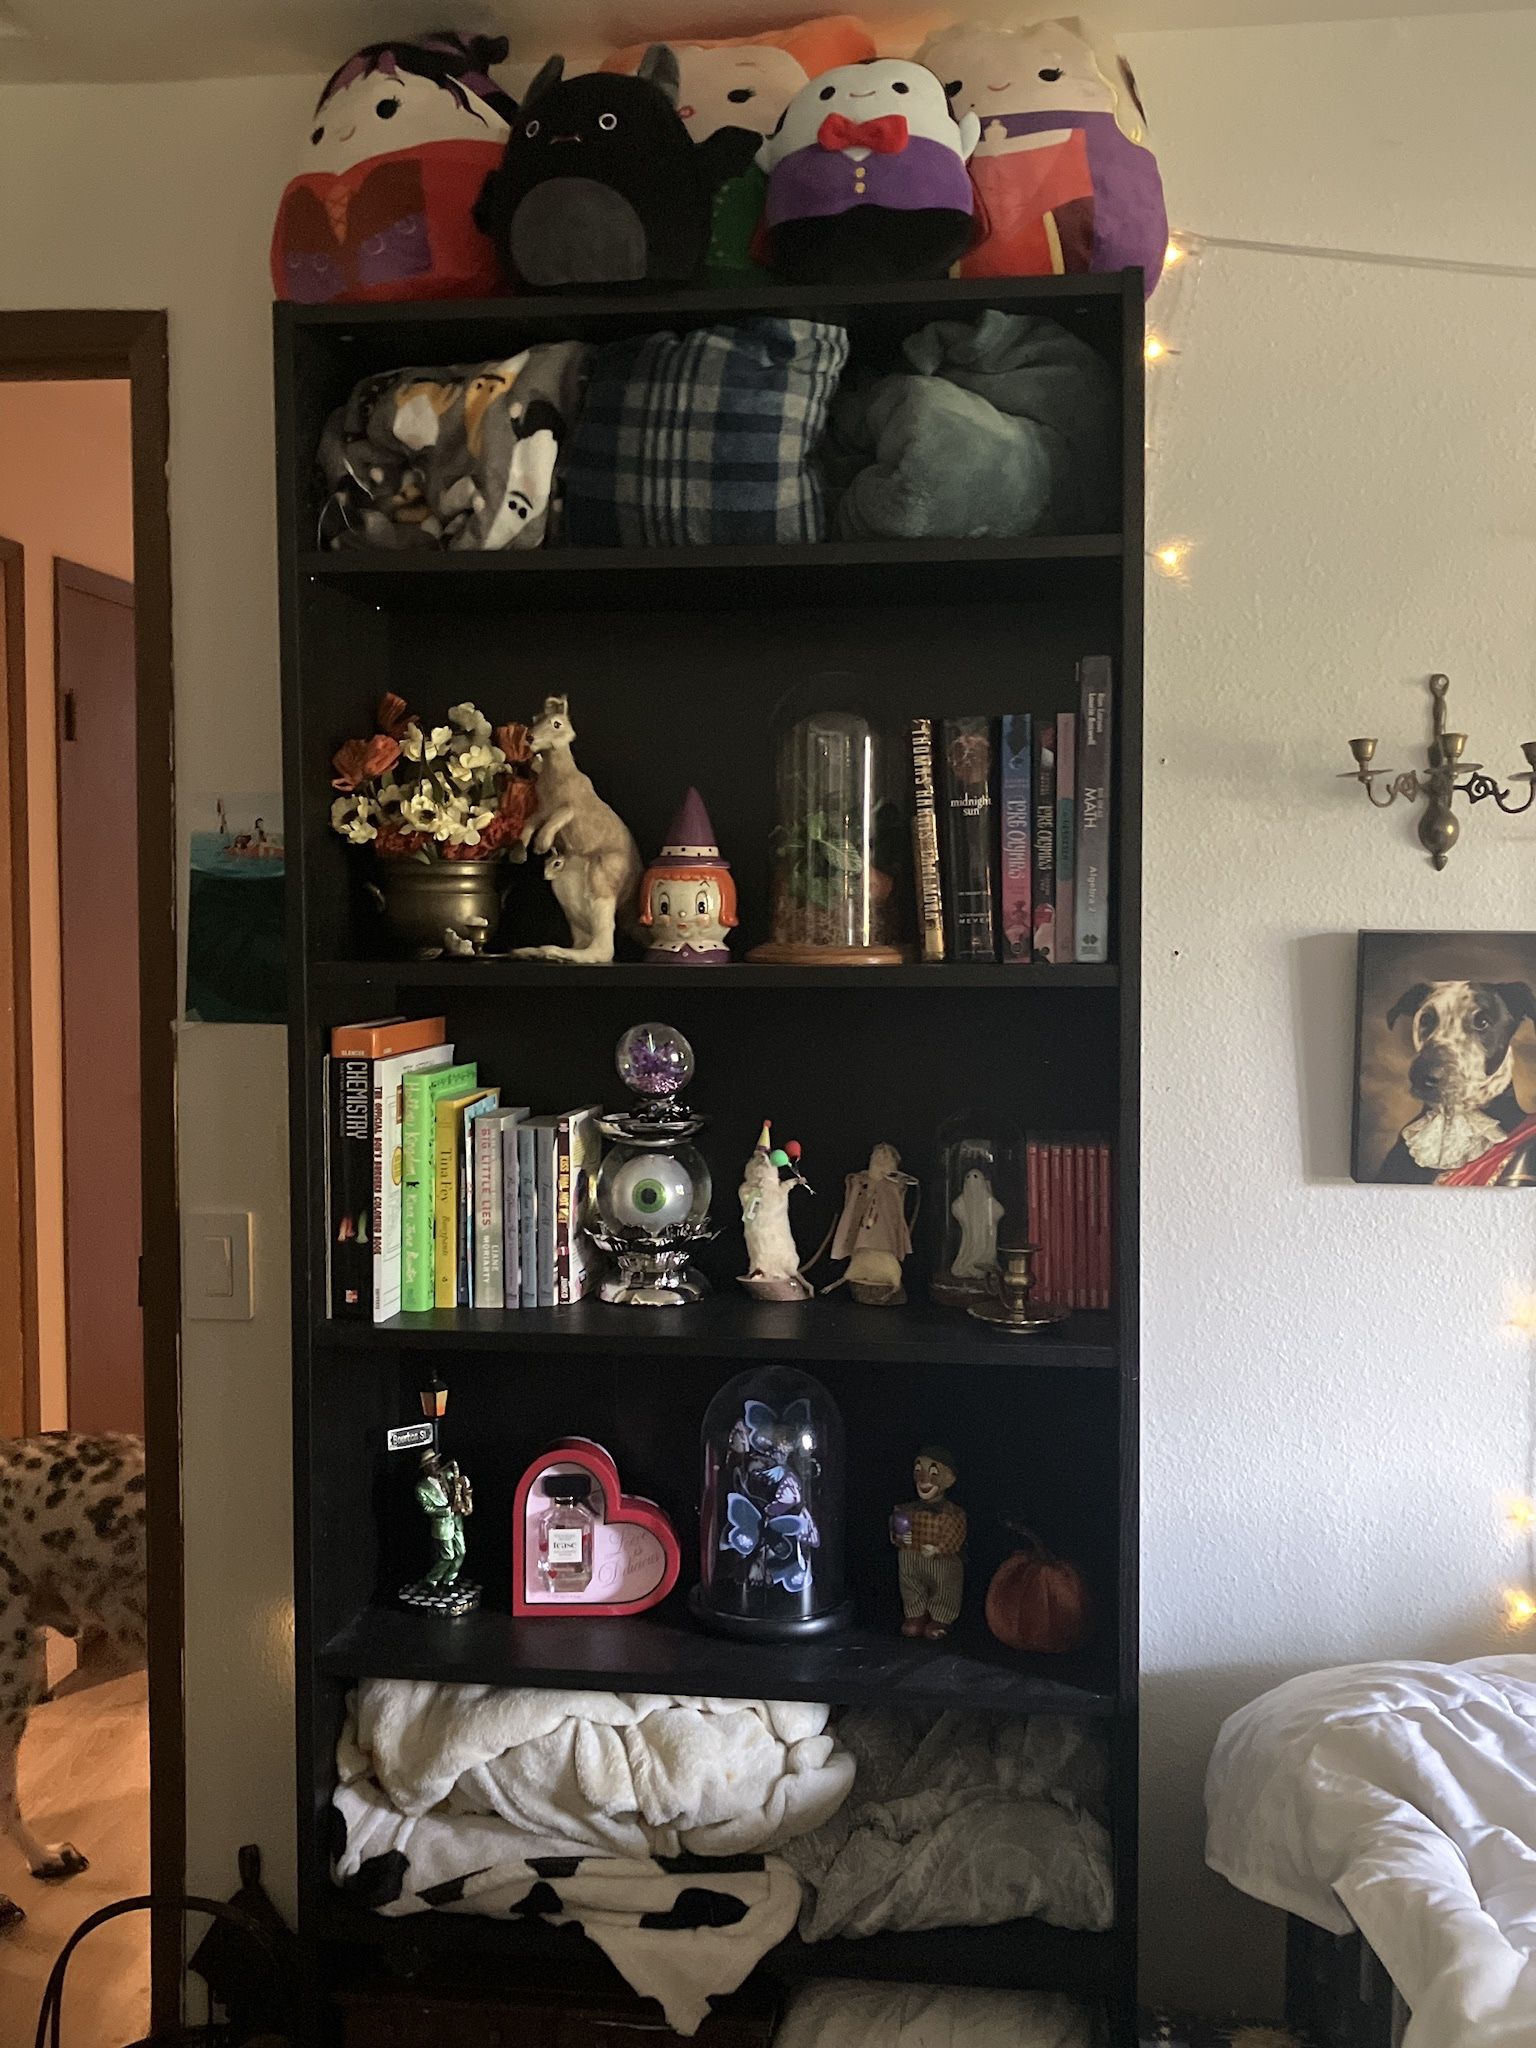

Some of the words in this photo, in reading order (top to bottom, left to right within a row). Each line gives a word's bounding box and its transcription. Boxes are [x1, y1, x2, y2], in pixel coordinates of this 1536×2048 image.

[912, 725, 932, 785] THOMAS
[950, 792, 993, 809] midnight
[962, 807, 980, 816] sun
[1087, 866, 1098, 904] Algebra
[345, 1061, 368, 1140] CHEMISTRY
[373, 1103, 382, 1134] OFFICIAL
[481, 1128, 491, 1150] BIG
[440, 1147, 453, 1178] Tina
[481, 1154, 491, 1194] LITTLE
[559, 1155, 569, 1173] KISS
[437, 1180, 452, 1202] Fey
[482, 1200, 491, 1227] LIES
[481, 1235, 491, 1284] MORIARTY
[490, 1244, 499, 1272] LIANE
[560, 1276, 568, 1299] JUNKO
